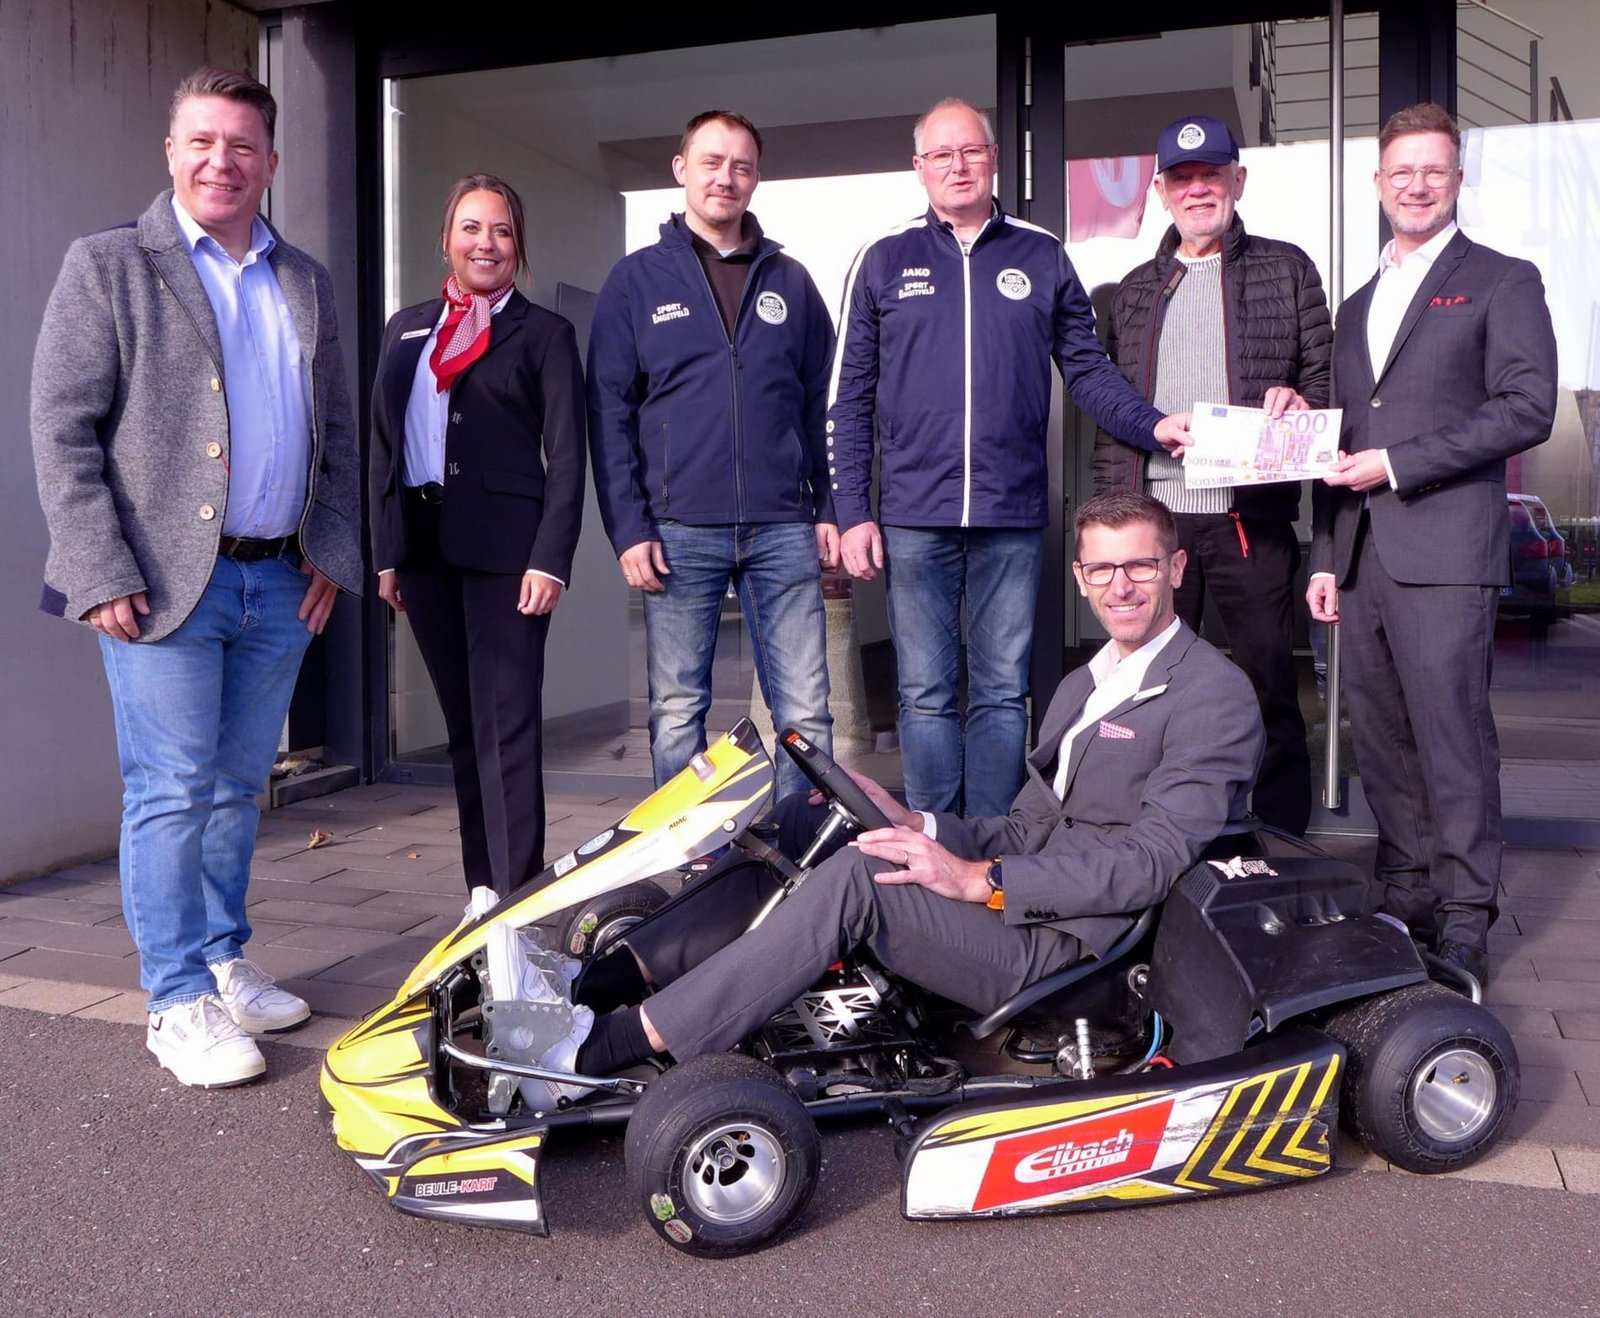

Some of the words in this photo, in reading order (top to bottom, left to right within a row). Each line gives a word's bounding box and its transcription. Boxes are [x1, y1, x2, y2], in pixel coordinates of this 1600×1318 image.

[902, 268, 930, 277] JAKO
[656, 303, 681, 314] SPORT
[1282, 412, 1328, 434] 500
[668, 815, 688, 830] ADAC
[1014, 1128, 1133, 1184] Eibach
[415, 1177, 498, 1197] BEULE-KART
